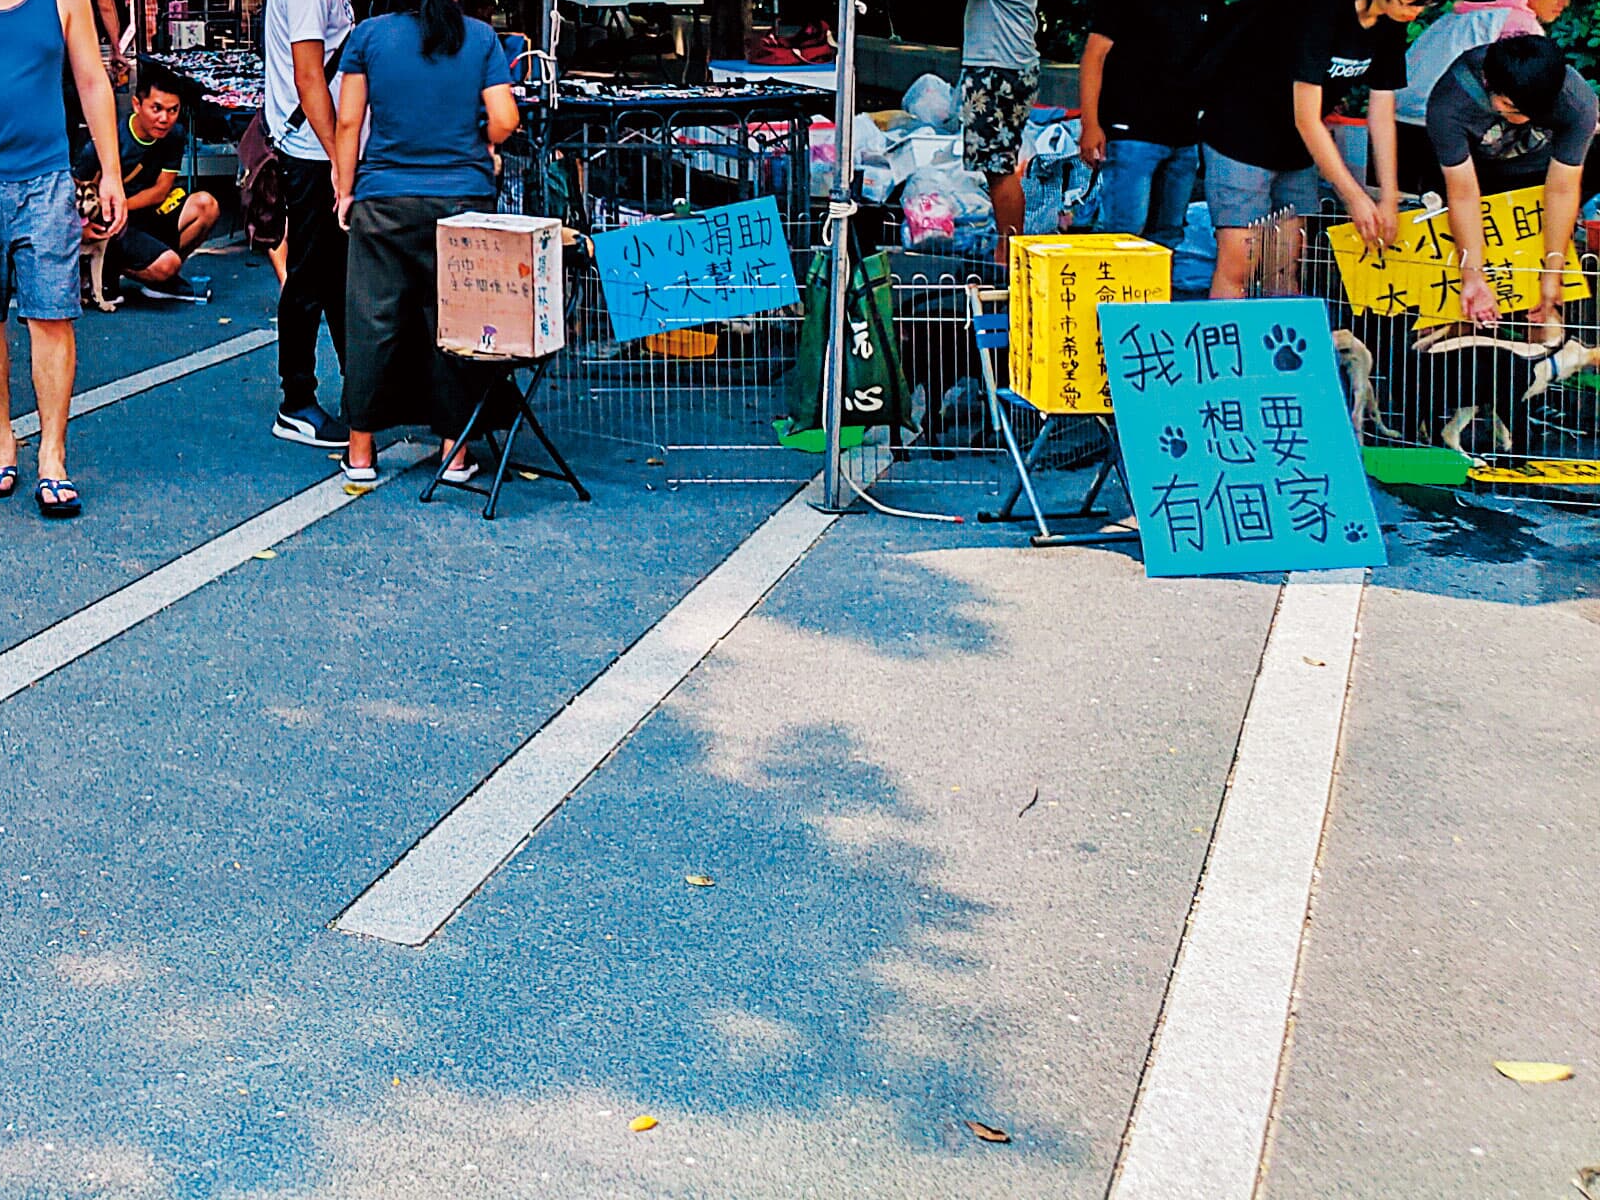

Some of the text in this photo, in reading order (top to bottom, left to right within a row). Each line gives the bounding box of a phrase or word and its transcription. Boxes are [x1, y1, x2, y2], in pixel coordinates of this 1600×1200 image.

[623, 210, 773, 268] 小小捐助
[631, 257, 777, 321] 大大幫忙
[1122, 285, 1164, 304] Hope
[1059, 263, 1081, 409] 台中市希望愛
[1119, 322, 1244, 392] 我們
[1199, 396, 1309, 467] 想要
[1149, 466, 1337, 553] 有個家
